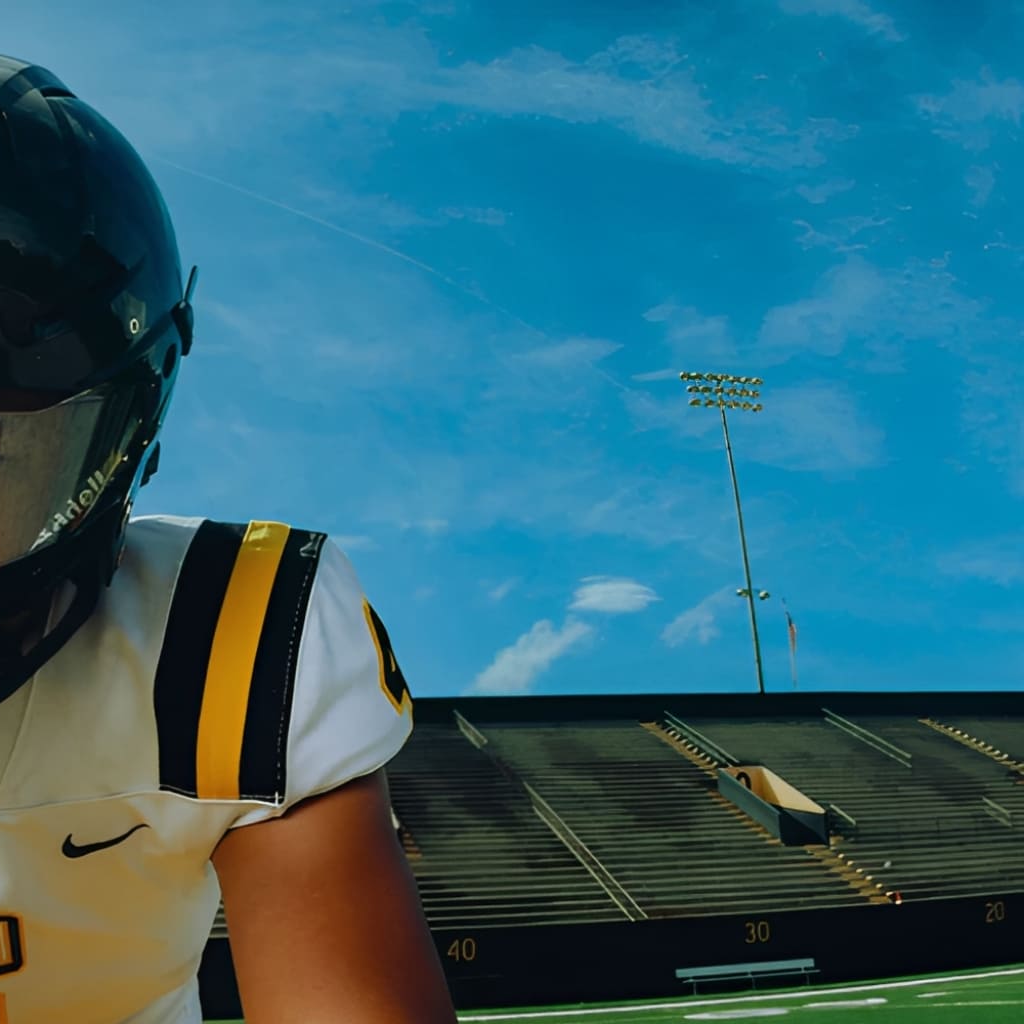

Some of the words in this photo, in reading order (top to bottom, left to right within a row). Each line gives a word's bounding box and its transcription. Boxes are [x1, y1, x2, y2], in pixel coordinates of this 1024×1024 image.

[985, 901, 1005, 923] 20
[745, 921, 770, 944] 30
[447, 937, 476, 962] 40
